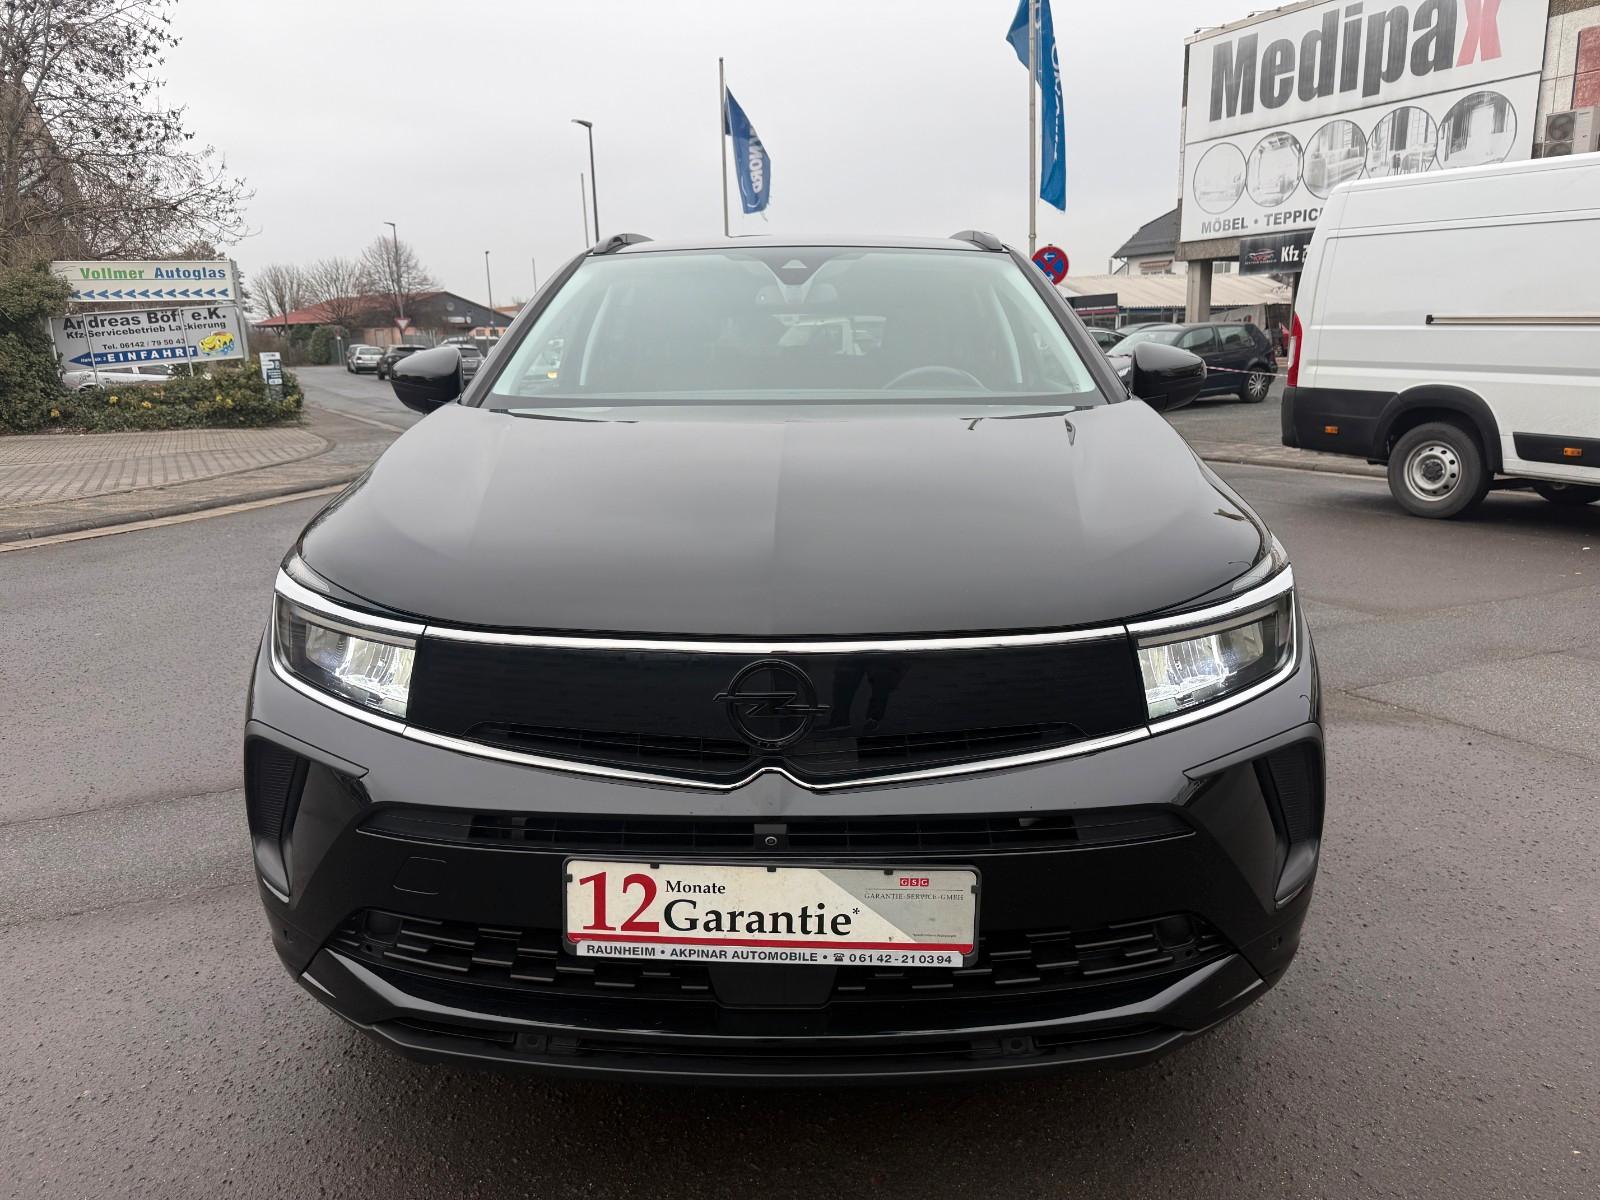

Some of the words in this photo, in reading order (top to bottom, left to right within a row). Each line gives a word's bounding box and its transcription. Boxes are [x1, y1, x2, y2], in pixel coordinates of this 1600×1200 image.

[1201, 217, 1249, 234] MÖBEL
[1280, 245, 1299, 262] Kfz
[80, 267, 144, 279] Vollmer
[155, 267, 226, 281] Autoglas
[63, 315, 141, 330] Andreas
[191, 307, 227, 320] e.K.
[66, 324, 166, 340] Kfz-Servicebetrieb
[102, 343, 118, 351] Tel.
[119, 341, 145, 349] 06142
[107, 347, 196, 363] EINFAHRT
[665, 880, 726, 894] Monate
[579, 871, 660, 932] 12
[587, 944, 656, 956] RAUNHEIM
[670, 948, 727, 959] AKPINAR
[732, 950, 818, 962] AUTOMOBILE
